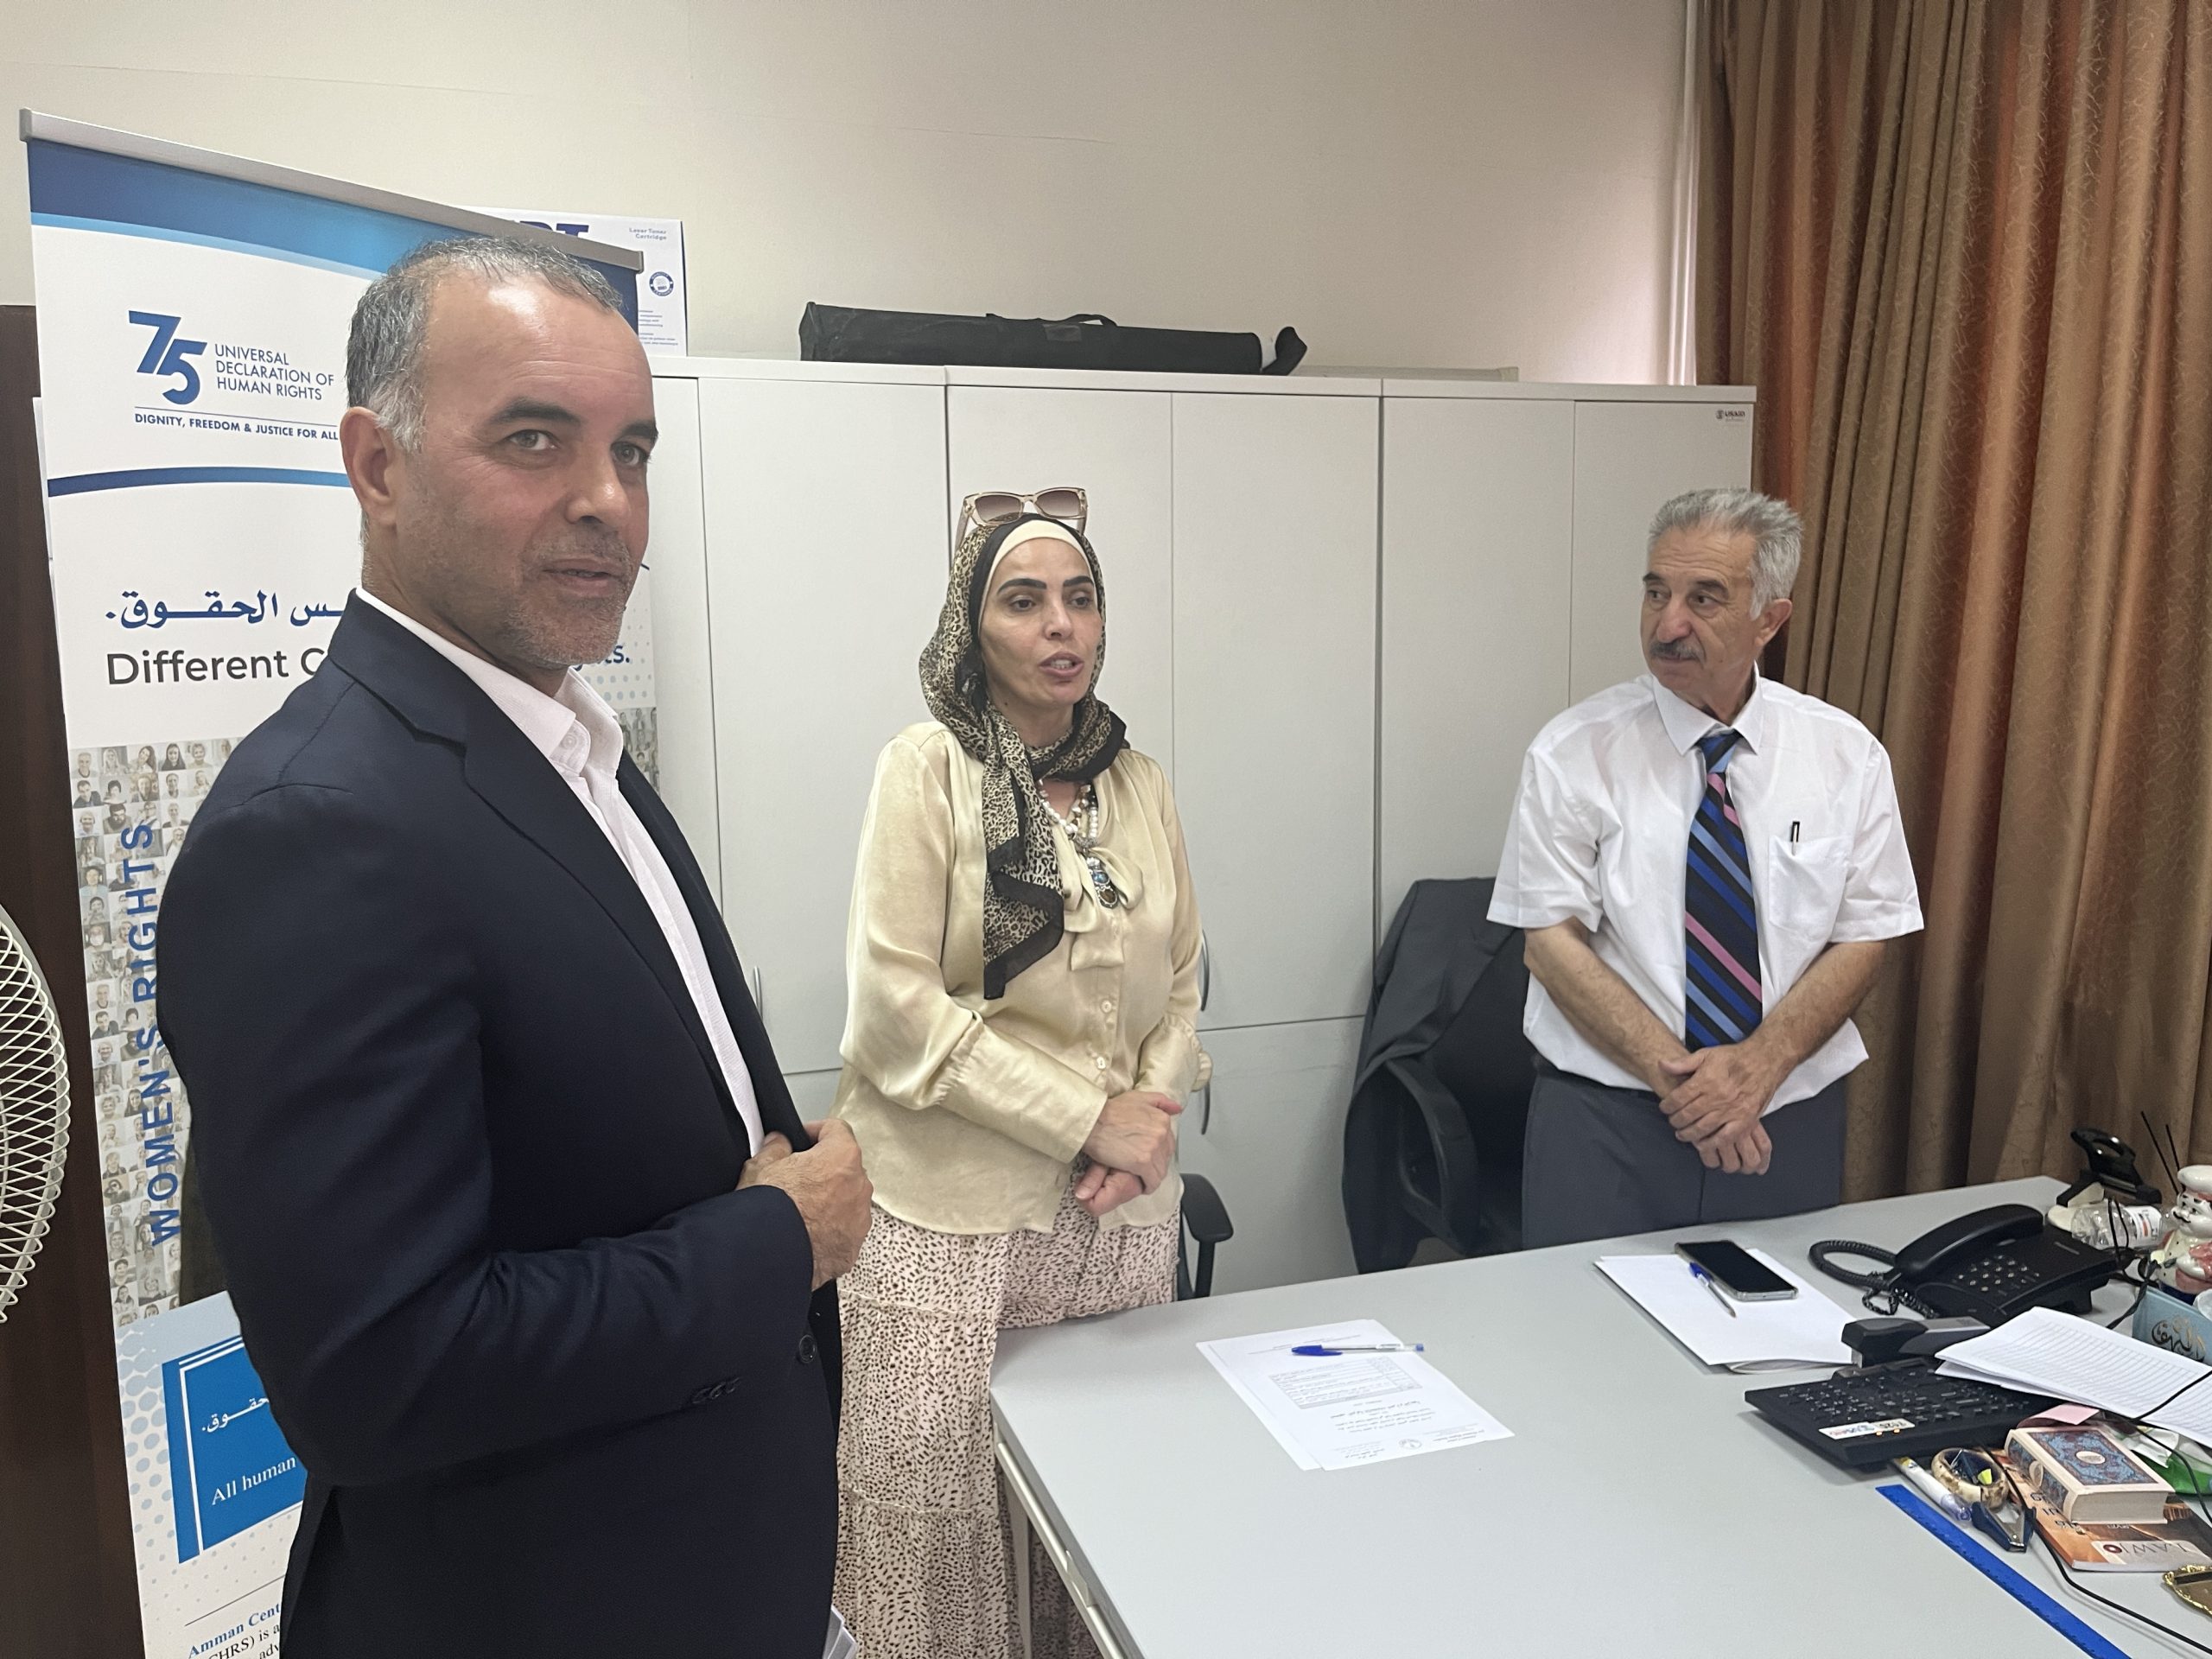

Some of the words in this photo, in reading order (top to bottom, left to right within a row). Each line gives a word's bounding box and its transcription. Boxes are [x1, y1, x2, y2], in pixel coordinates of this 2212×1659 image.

[128, 309, 208, 405] 75
[214, 343, 289, 365] UNIVERSAL
[216, 359, 311, 384] DECLARATION
[315, 372, 334, 386] OF
[217, 376, 271, 395] HUMAN
[276, 383, 322, 401] RIGHTS
[135, 413, 185, 429] DIGNITY,
[188, 417, 240, 432] FREEDOM
[244, 423, 252, 433] &
[255, 424, 294, 437] JUSTICE
[296, 428, 318, 439] FOR
[321, 430, 339, 441] ALL
[106, 650, 289, 685] Different
[121, 824, 159, 1003] RIGHTS
[136, 1024, 181, 1247] WOMEN'S
[212, 1471, 238, 1505] All
[242, 1457, 296, 1491] human
[188, 1624, 245, 1659] Amman
[248, 1603, 280, 1627] Cent
[259, 1630, 269, 1642] is
